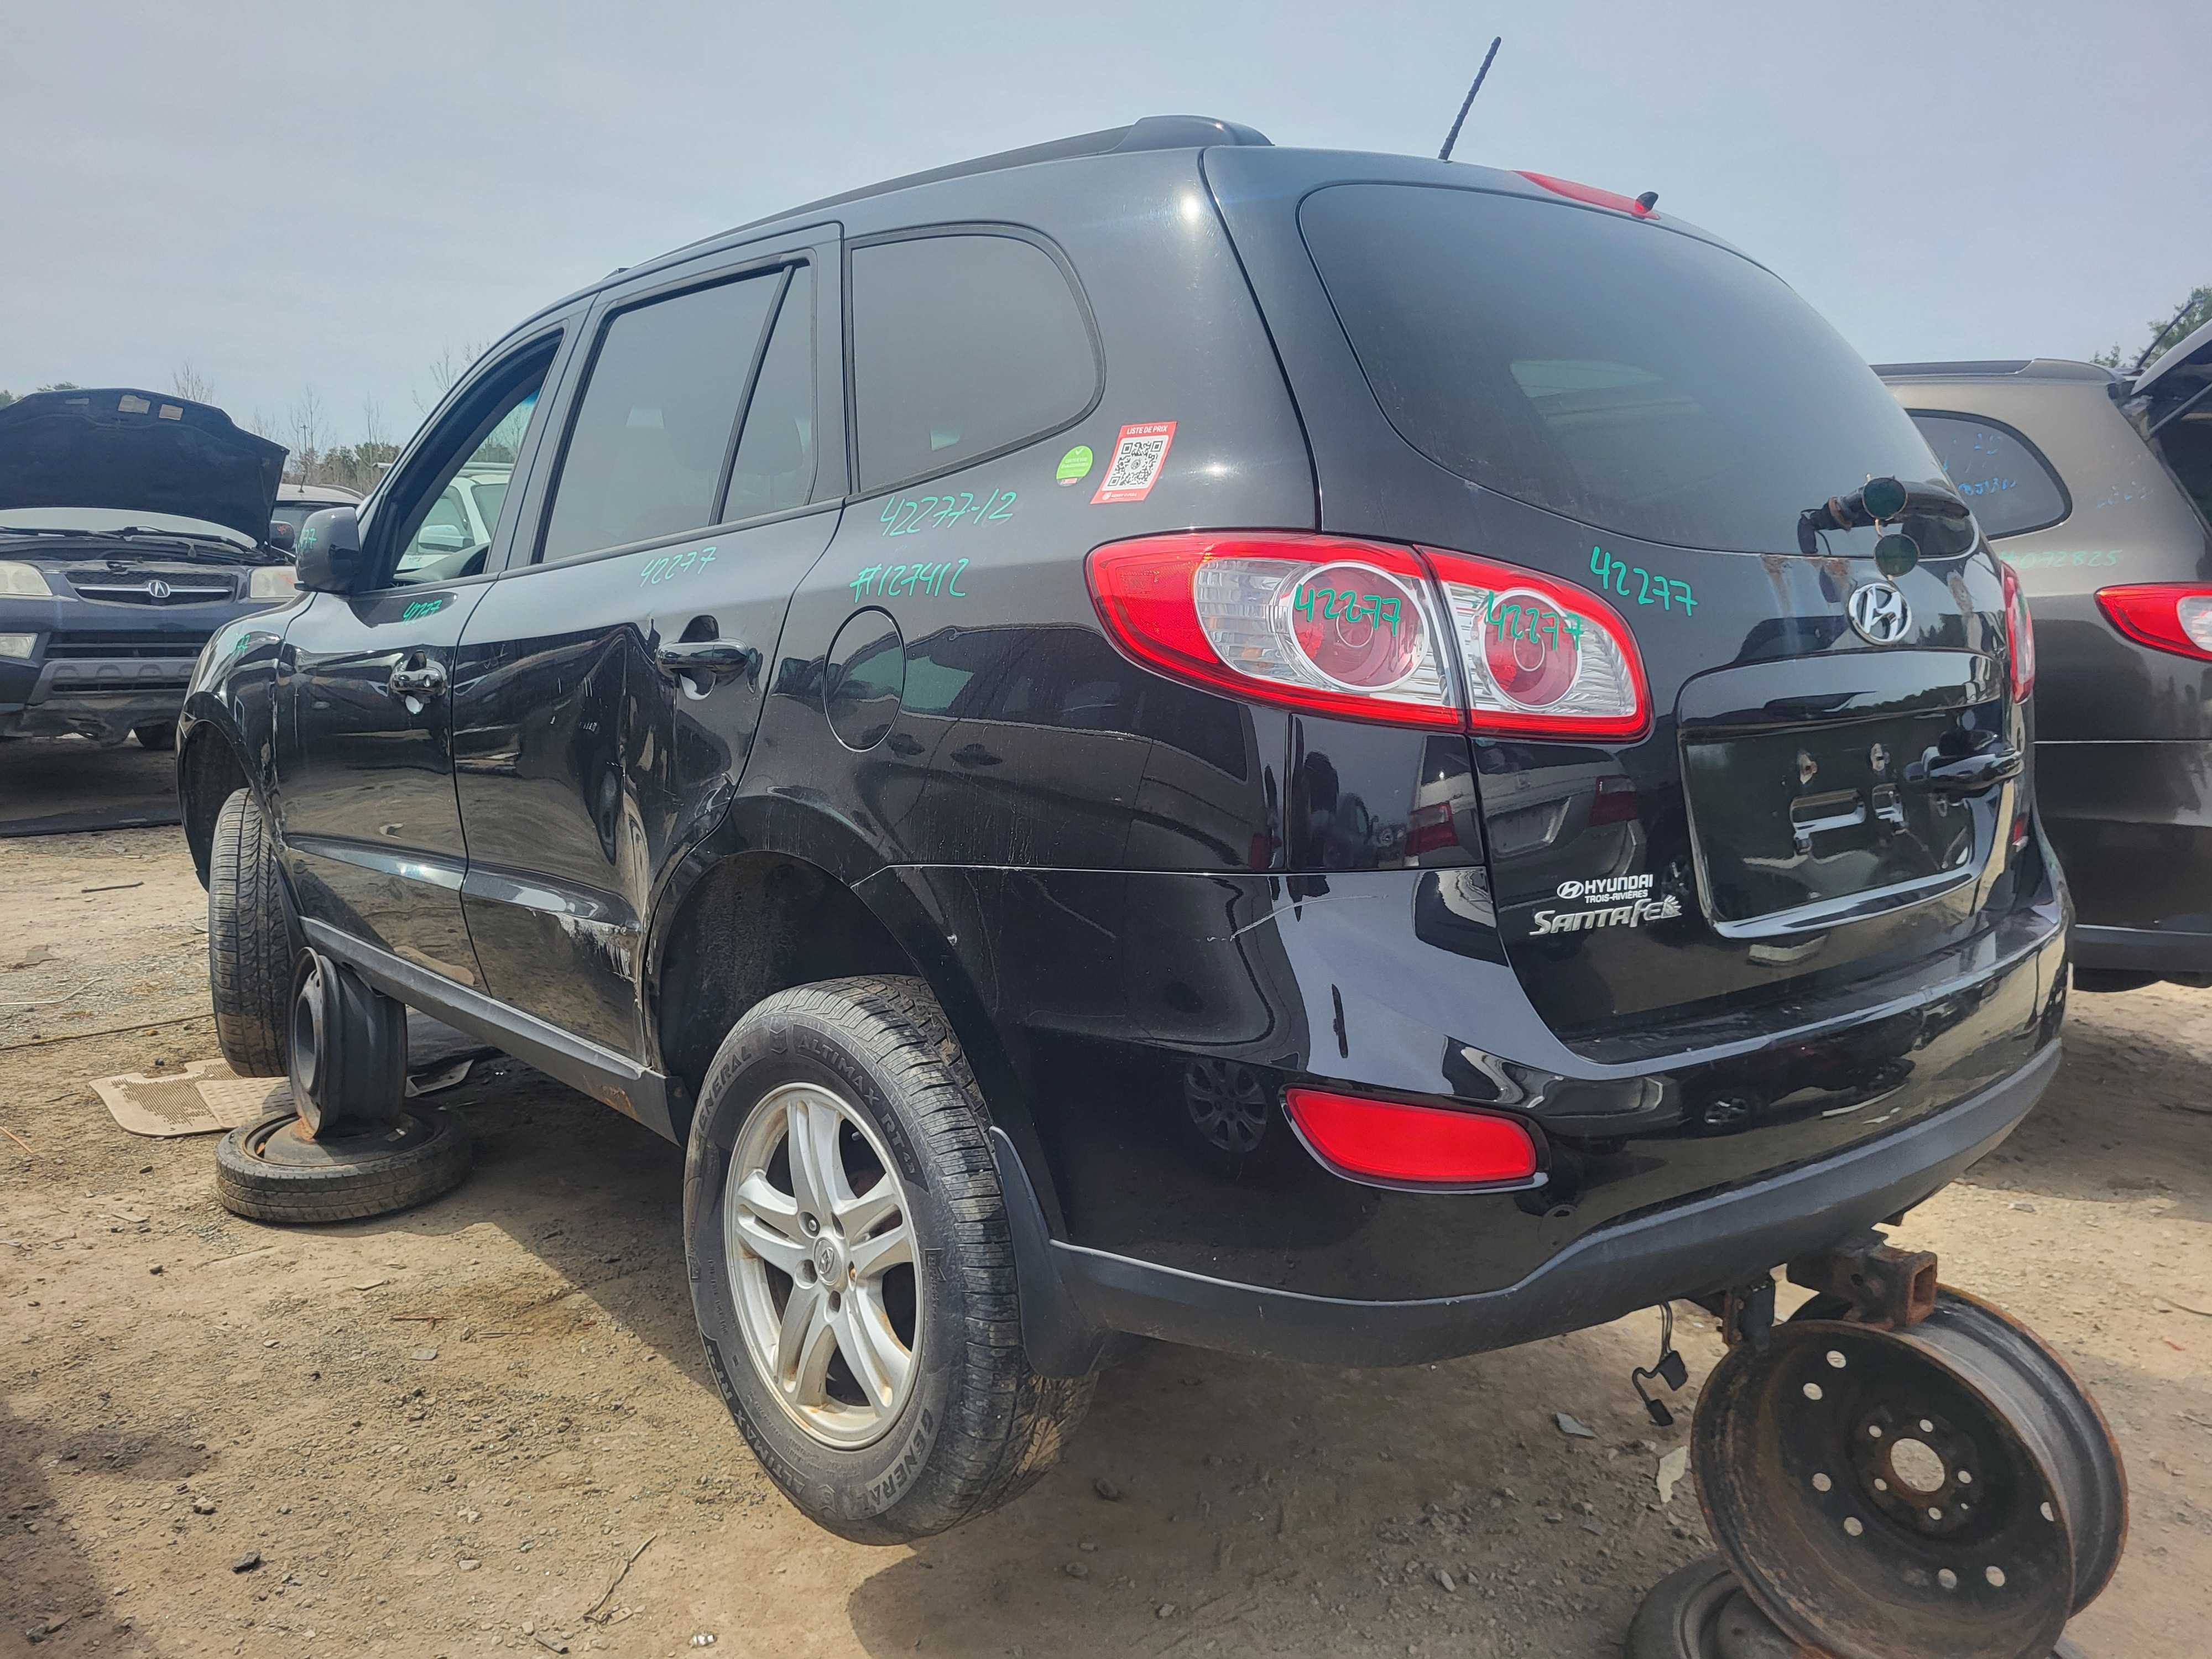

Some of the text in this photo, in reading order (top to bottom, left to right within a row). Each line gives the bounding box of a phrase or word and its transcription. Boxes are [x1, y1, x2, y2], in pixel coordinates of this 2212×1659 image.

[1126, 426, 1142, 435] LISTE
[880, 488, 1017, 538] 42277-12
[640, 546, 717, 587] 42277
[1589, 546, 1698, 616] 42277
[1295, 583, 1401, 637] 42277
[1484, 591, 1584, 650] 42277
[1584, 874, 1653, 894] HYUNDAI
[799, 1035, 880, 1103] ALTIMAX
[734, 1409, 805, 1493] ALTIMAX
[857, 1408, 933, 1511] GENERAL
